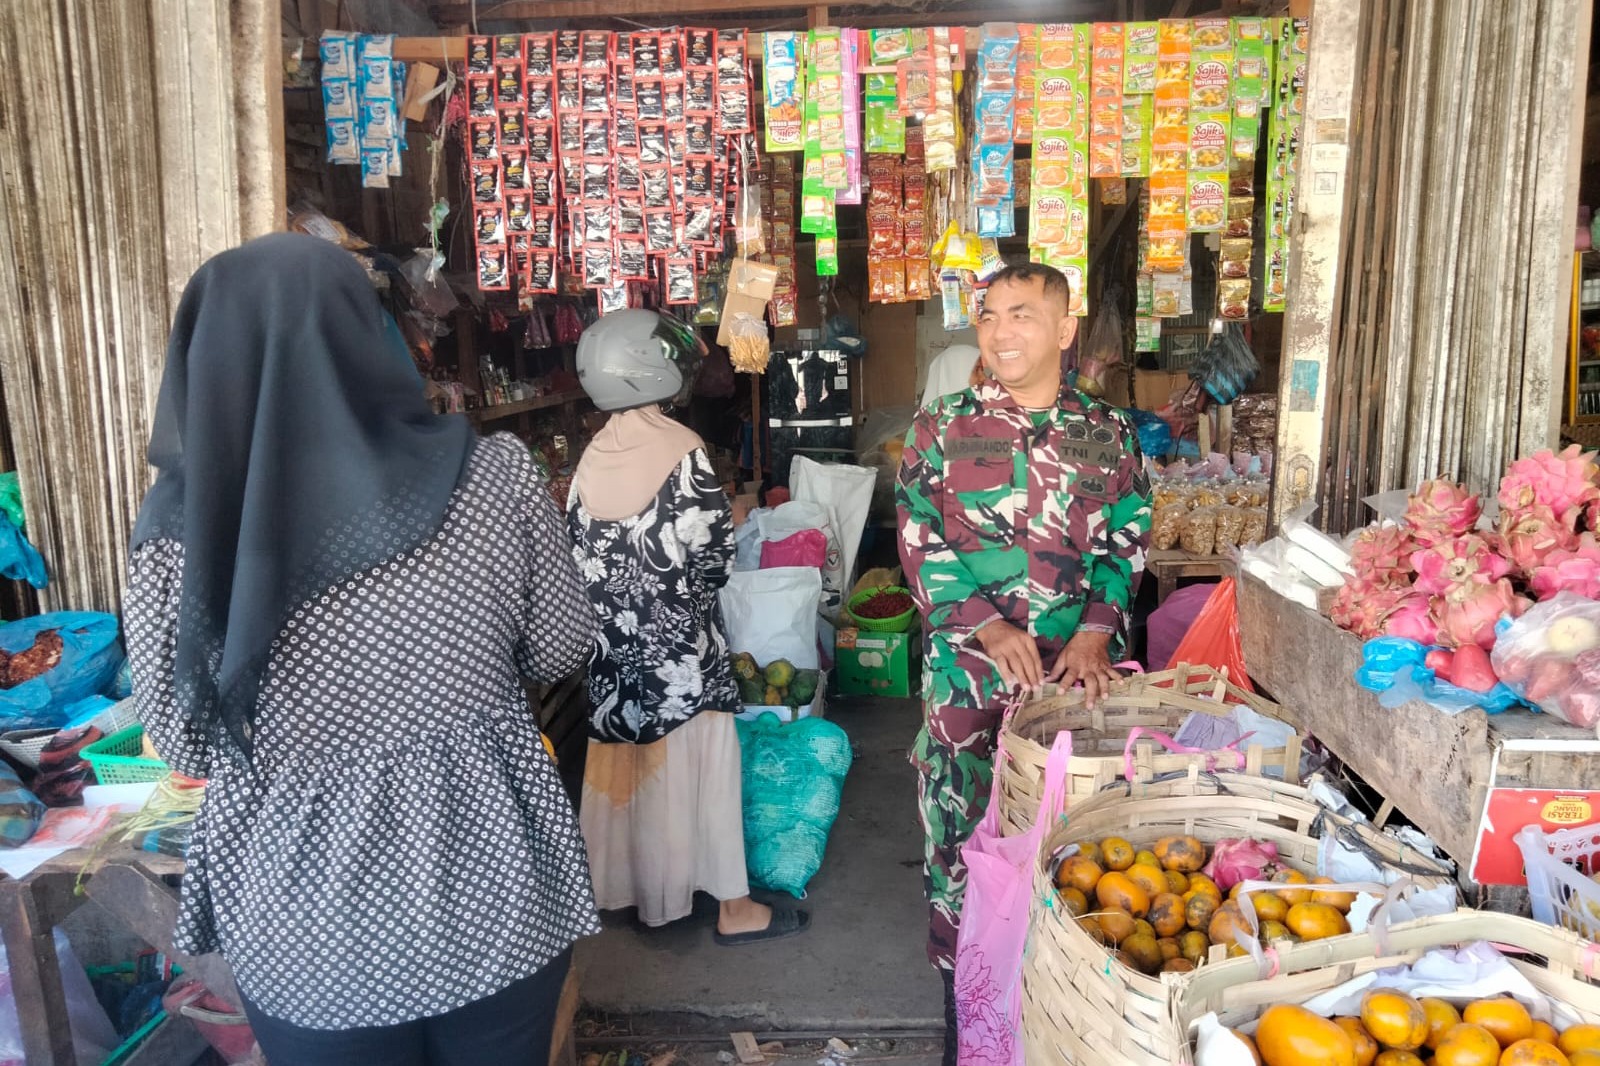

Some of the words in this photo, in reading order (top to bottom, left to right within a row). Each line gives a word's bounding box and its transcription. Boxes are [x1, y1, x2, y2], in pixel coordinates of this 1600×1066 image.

[1042, 23, 1073, 35] Sajiku
[1195, 62, 1227, 79] Sajiku
[1040, 81, 1071, 95] Sajiku
[1193, 124, 1225, 139] Sajiku
[1038, 140, 1069, 154] Sajiku
[1191, 184, 1223, 199] Sajiku
[1036, 199, 1066, 213] Sajiku
[1061, 446, 1088, 459] TNI
[1547, 811, 1584, 819] TERASI
